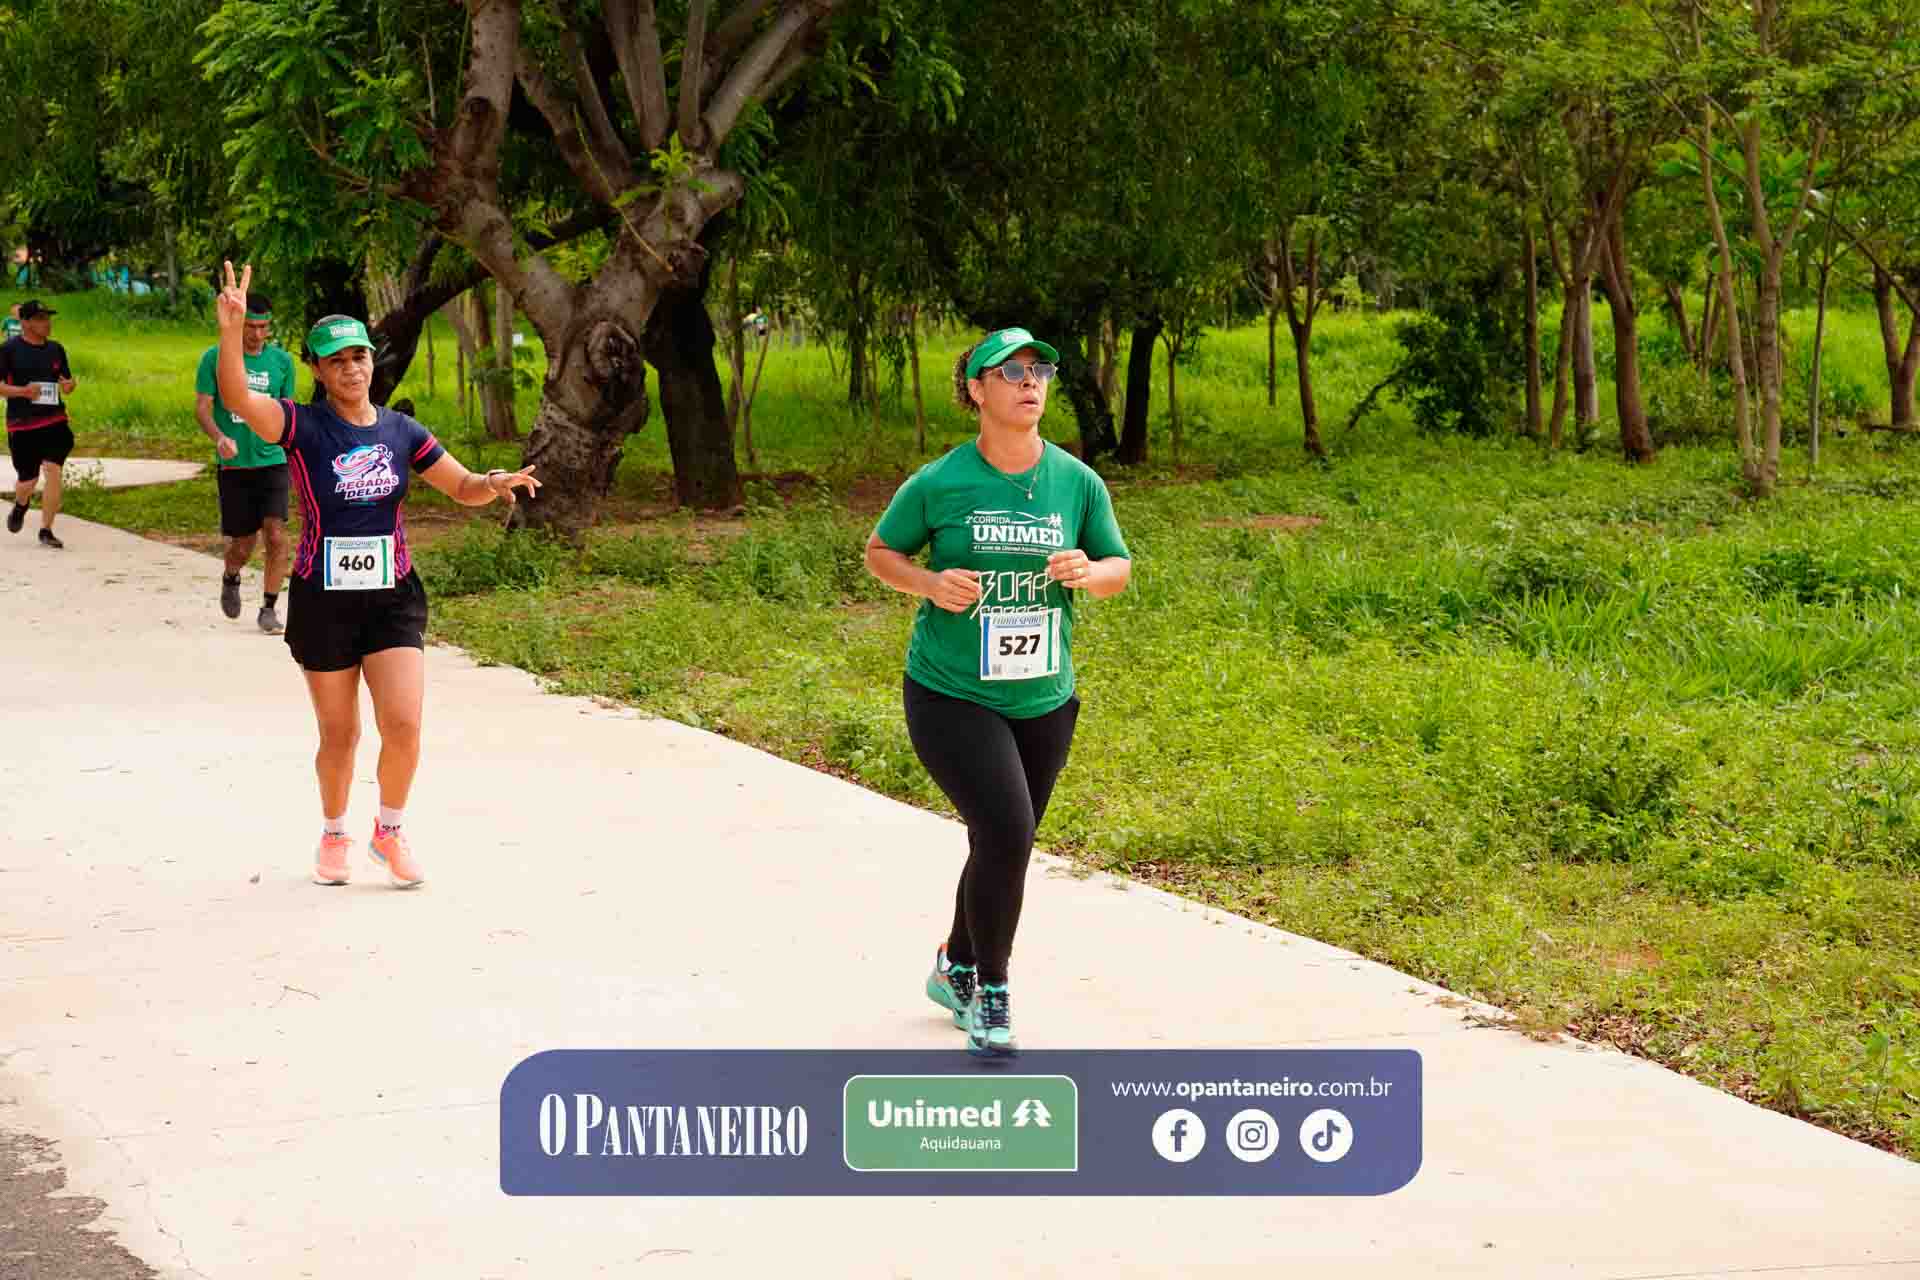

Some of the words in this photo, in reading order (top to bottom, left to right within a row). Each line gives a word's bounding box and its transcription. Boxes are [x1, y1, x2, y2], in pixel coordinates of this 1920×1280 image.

[335, 477, 398, 493] PEGADAS
[346, 486, 392, 499] DELAS
[973, 515, 1009, 525] CORRIDA
[972, 525, 1064, 547] UNIMED
[338, 555, 375, 571] 460
[999, 634, 1041, 656] 527
